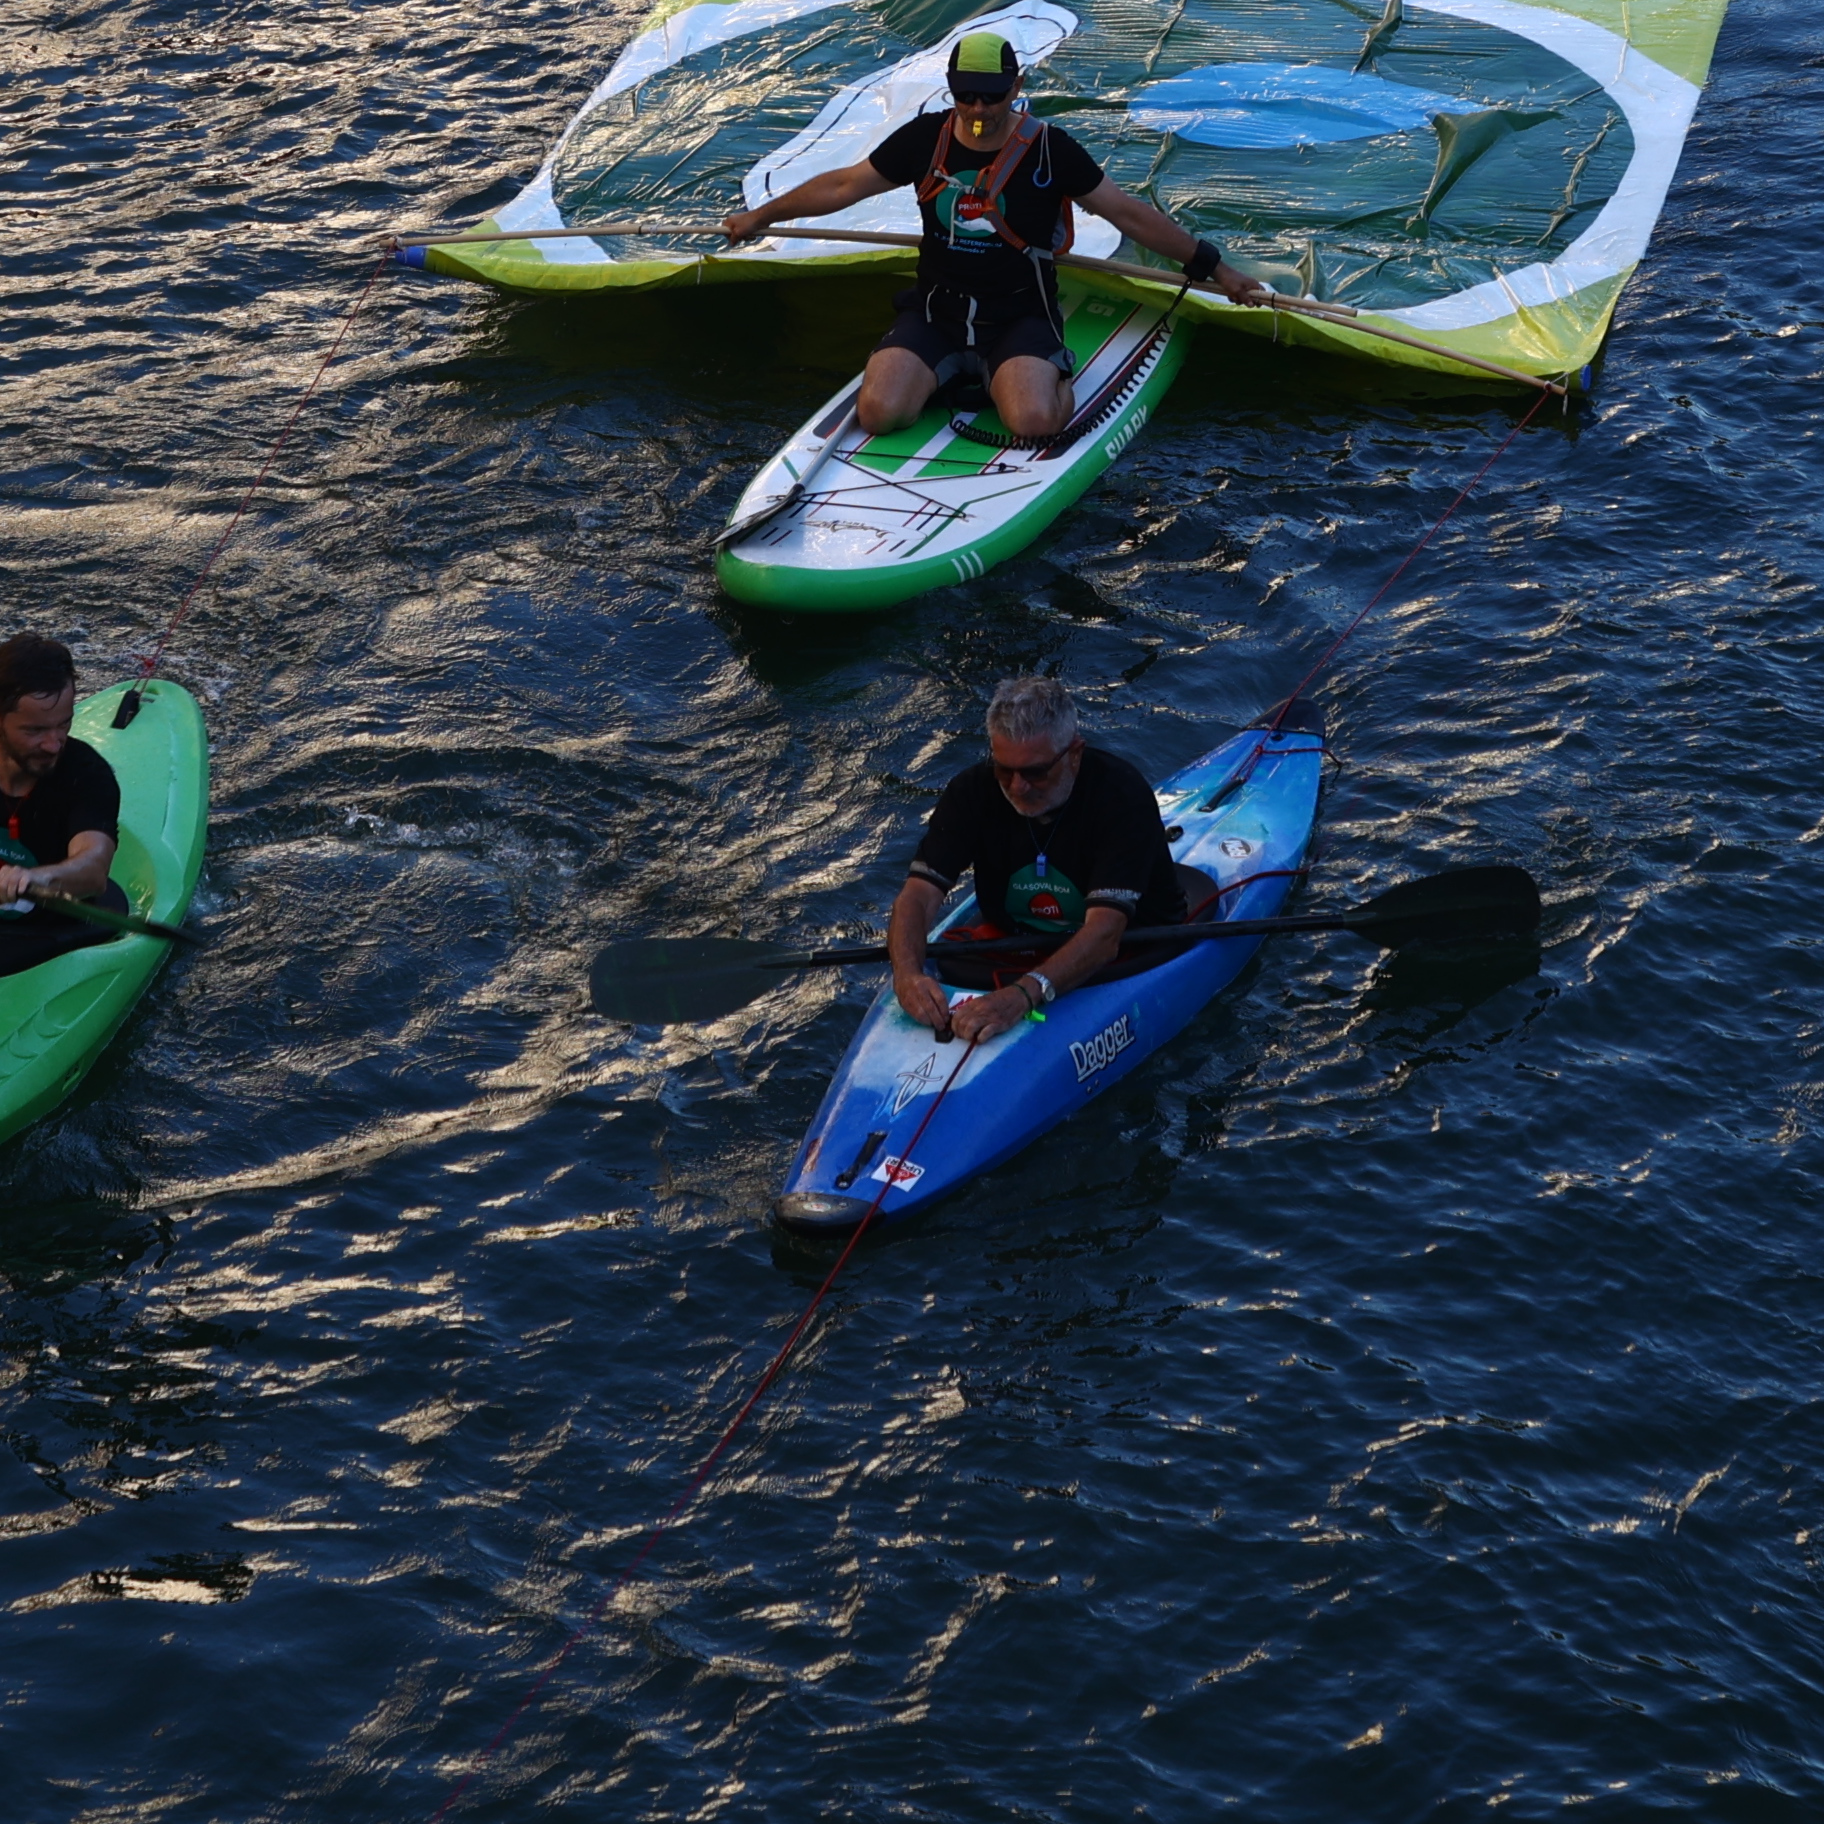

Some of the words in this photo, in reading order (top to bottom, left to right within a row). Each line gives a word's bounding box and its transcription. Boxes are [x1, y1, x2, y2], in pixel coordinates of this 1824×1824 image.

[958, 202, 983, 211] PROTI
[1012, 882, 1053, 892] GLASOVAL
[1053, 885, 1071, 894] BOM
[1030, 905, 1059, 915] PROTI
[1068, 1013, 1134, 1083] Dagger
